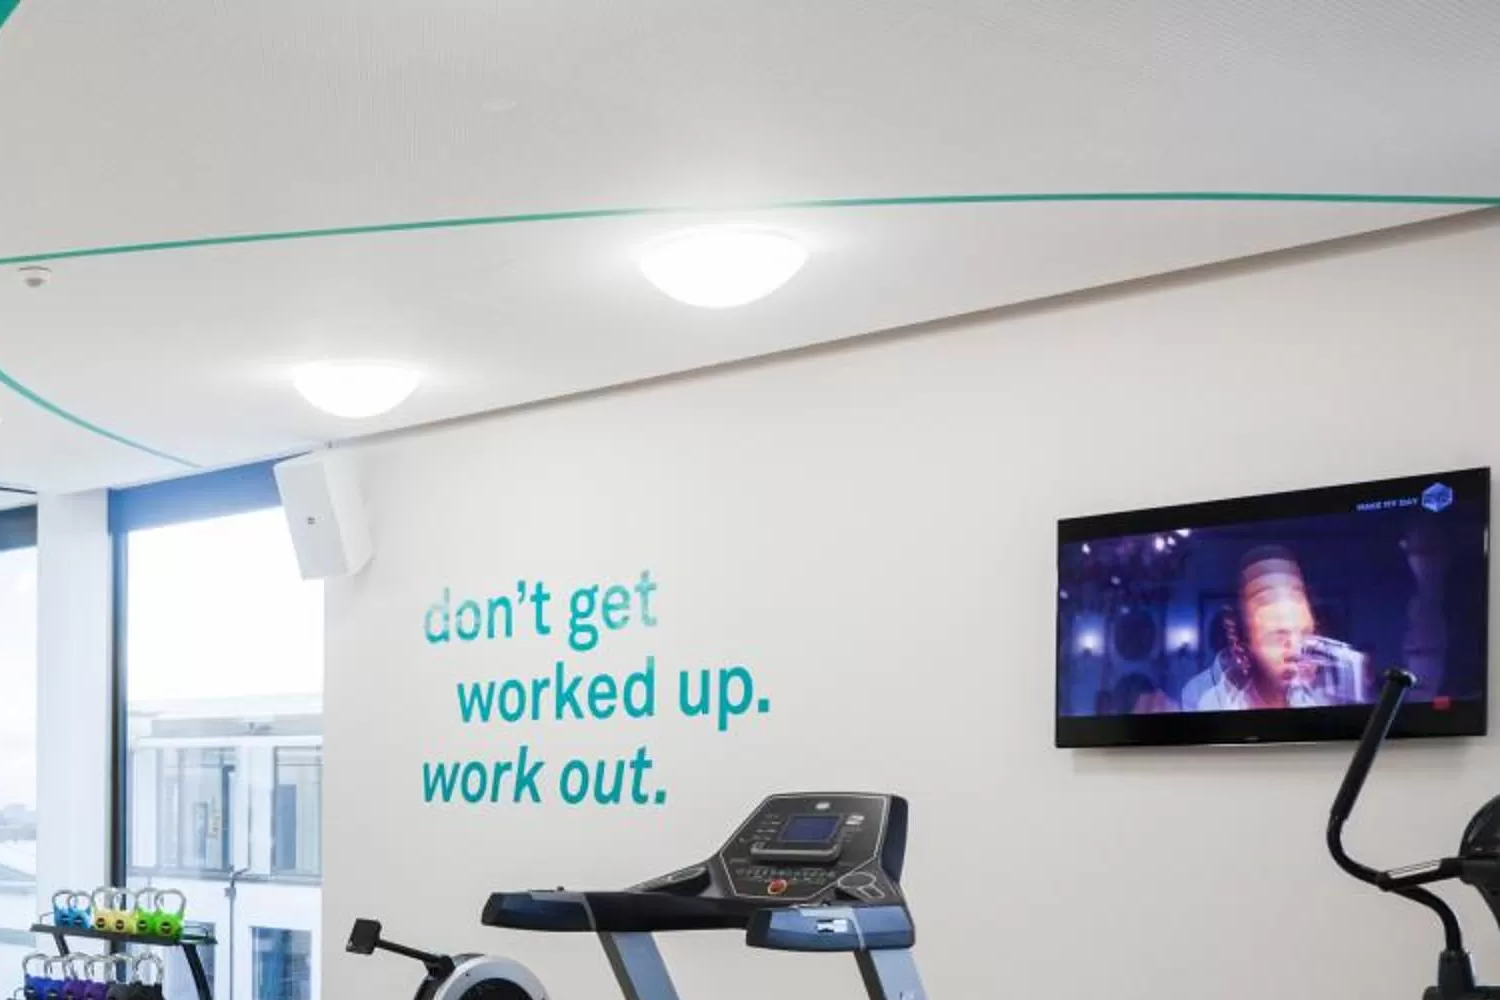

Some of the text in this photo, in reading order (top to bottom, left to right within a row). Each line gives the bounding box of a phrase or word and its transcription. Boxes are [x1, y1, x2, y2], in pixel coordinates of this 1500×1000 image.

[423, 569, 658, 653] don't get
[456, 655, 771, 732] worked up.
[422, 745, 667, 804] work out.
